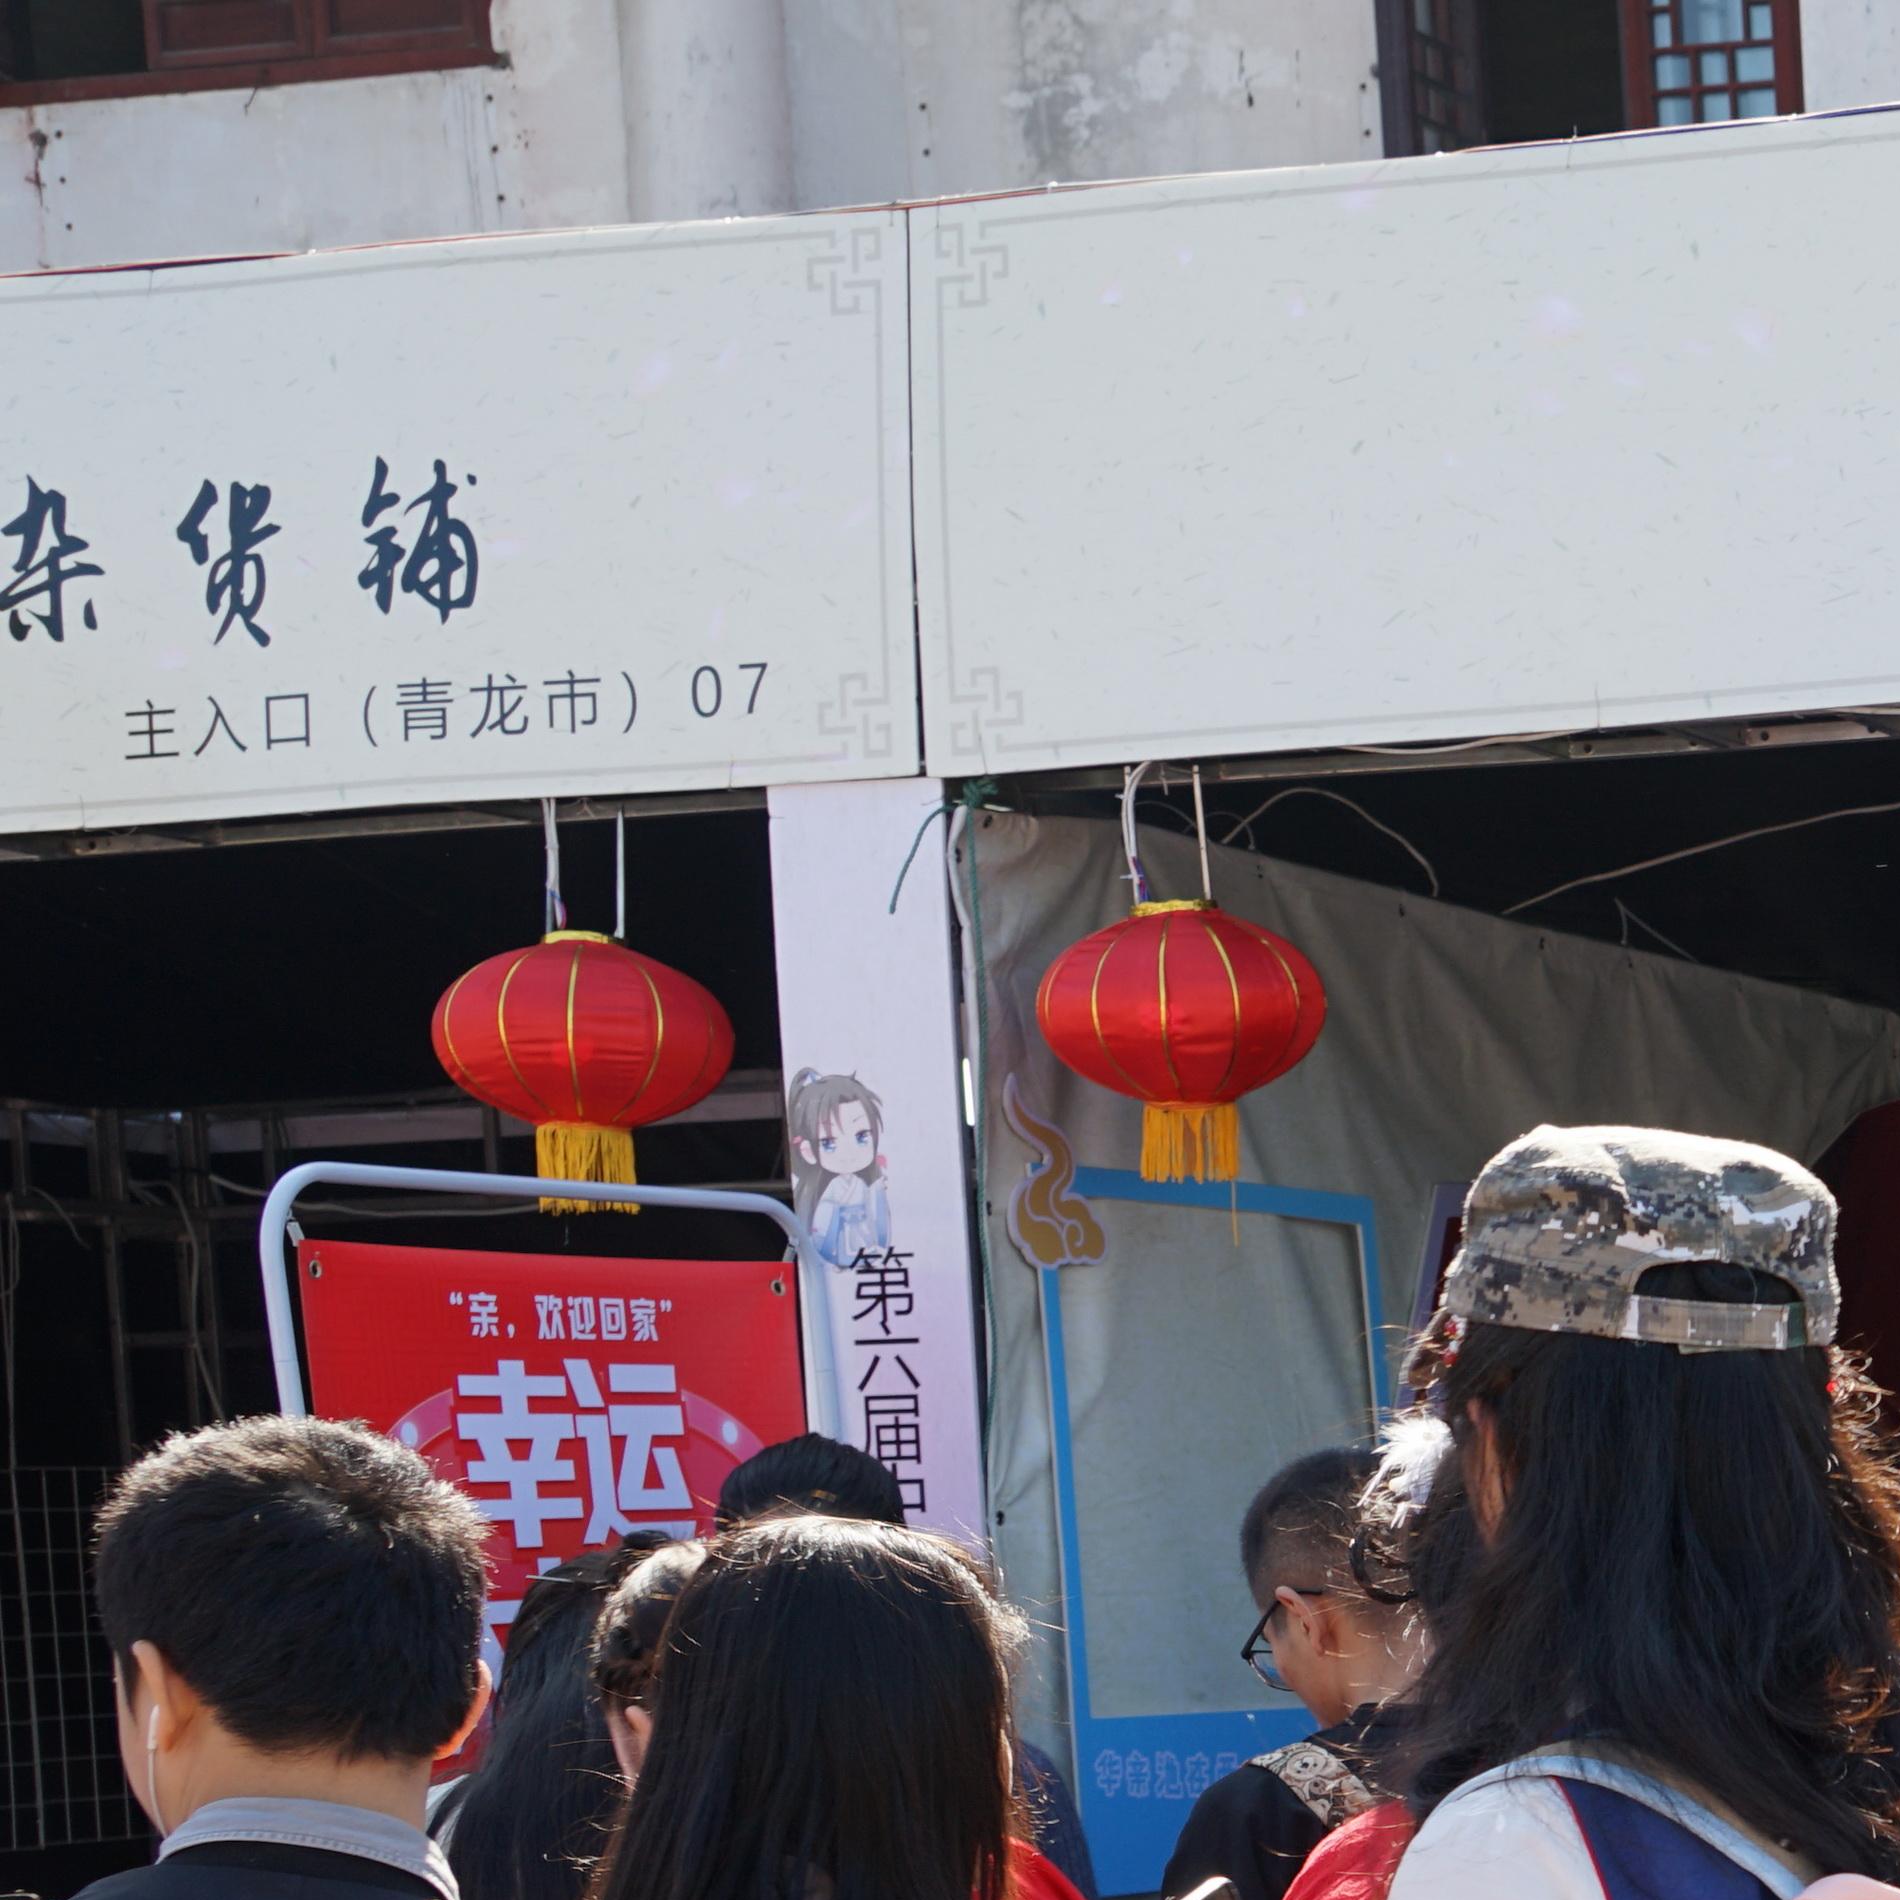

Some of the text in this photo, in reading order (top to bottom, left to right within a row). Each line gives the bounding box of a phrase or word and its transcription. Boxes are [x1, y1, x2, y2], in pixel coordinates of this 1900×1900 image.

[0, 455, 479, 647] 杂货铺
[456, 1358, 697, 1549] 幸运
